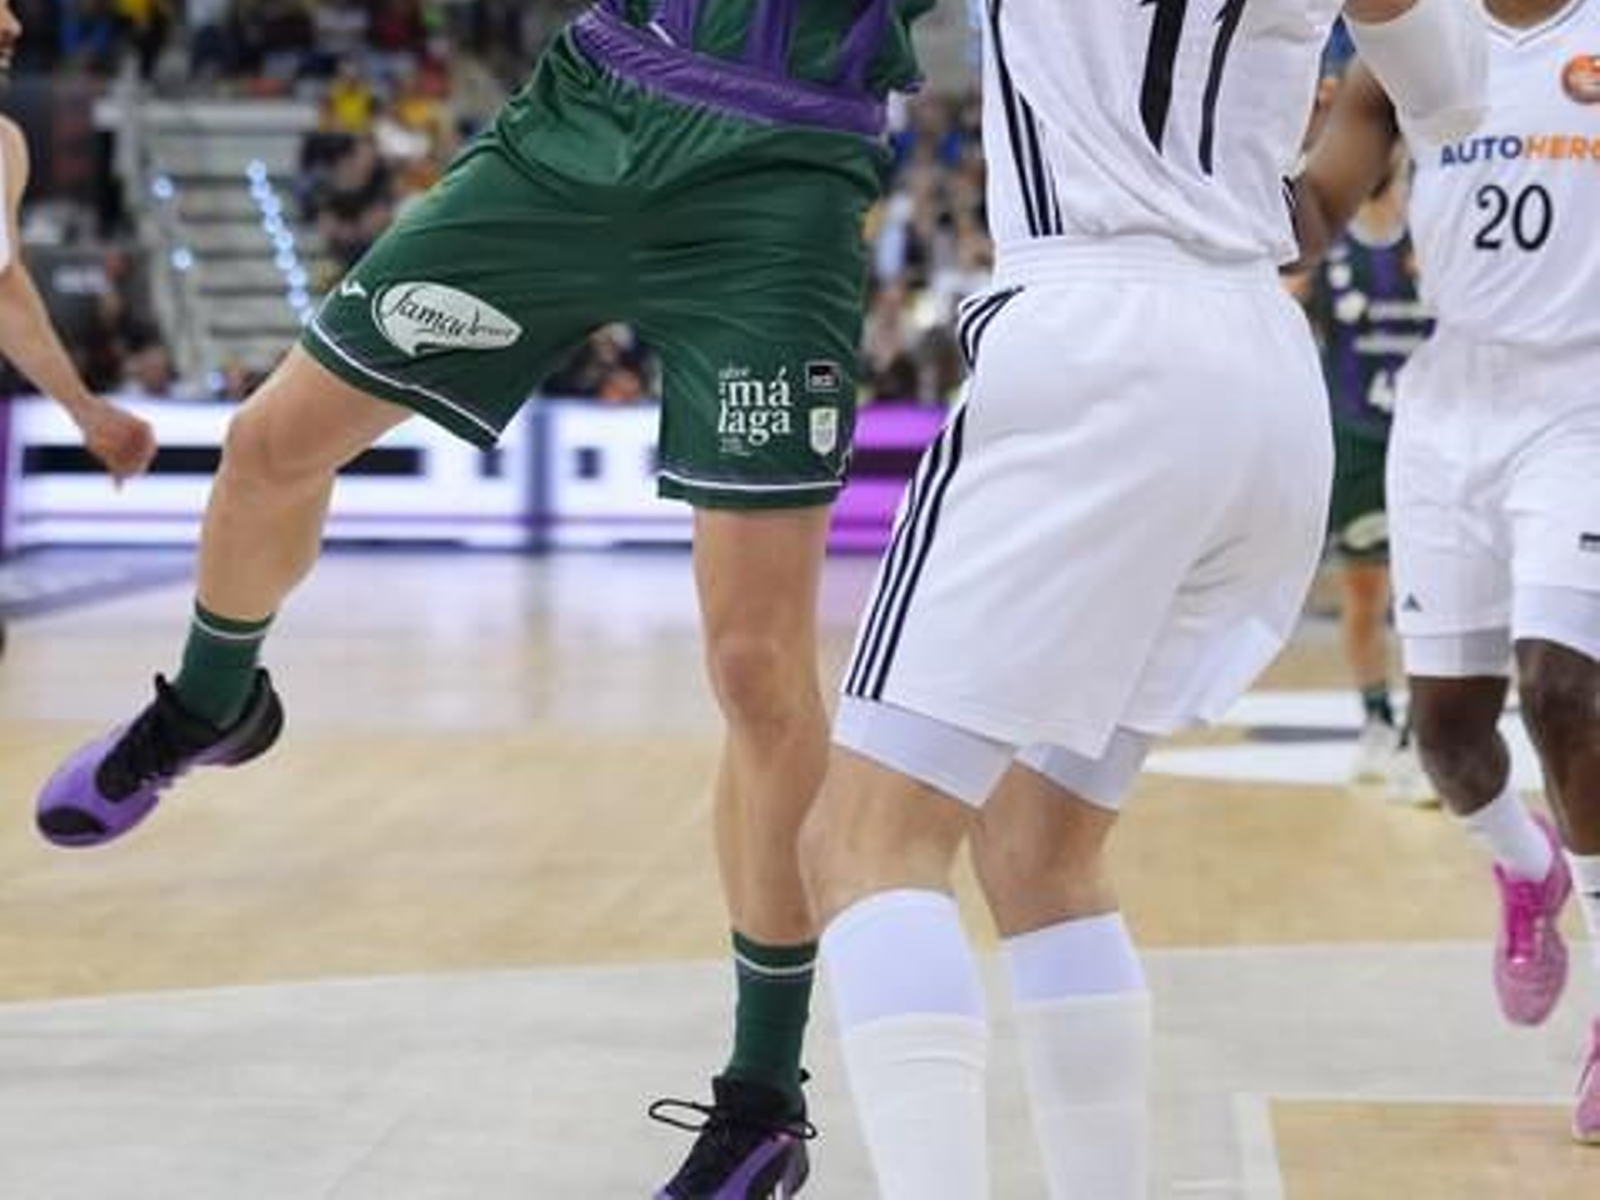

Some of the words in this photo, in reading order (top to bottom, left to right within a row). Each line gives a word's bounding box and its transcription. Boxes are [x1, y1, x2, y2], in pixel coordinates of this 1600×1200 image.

[1474, 183, 1553, 251] 20
[728, 364, 793, 407] má
[717, 399, 792, 447] laga
